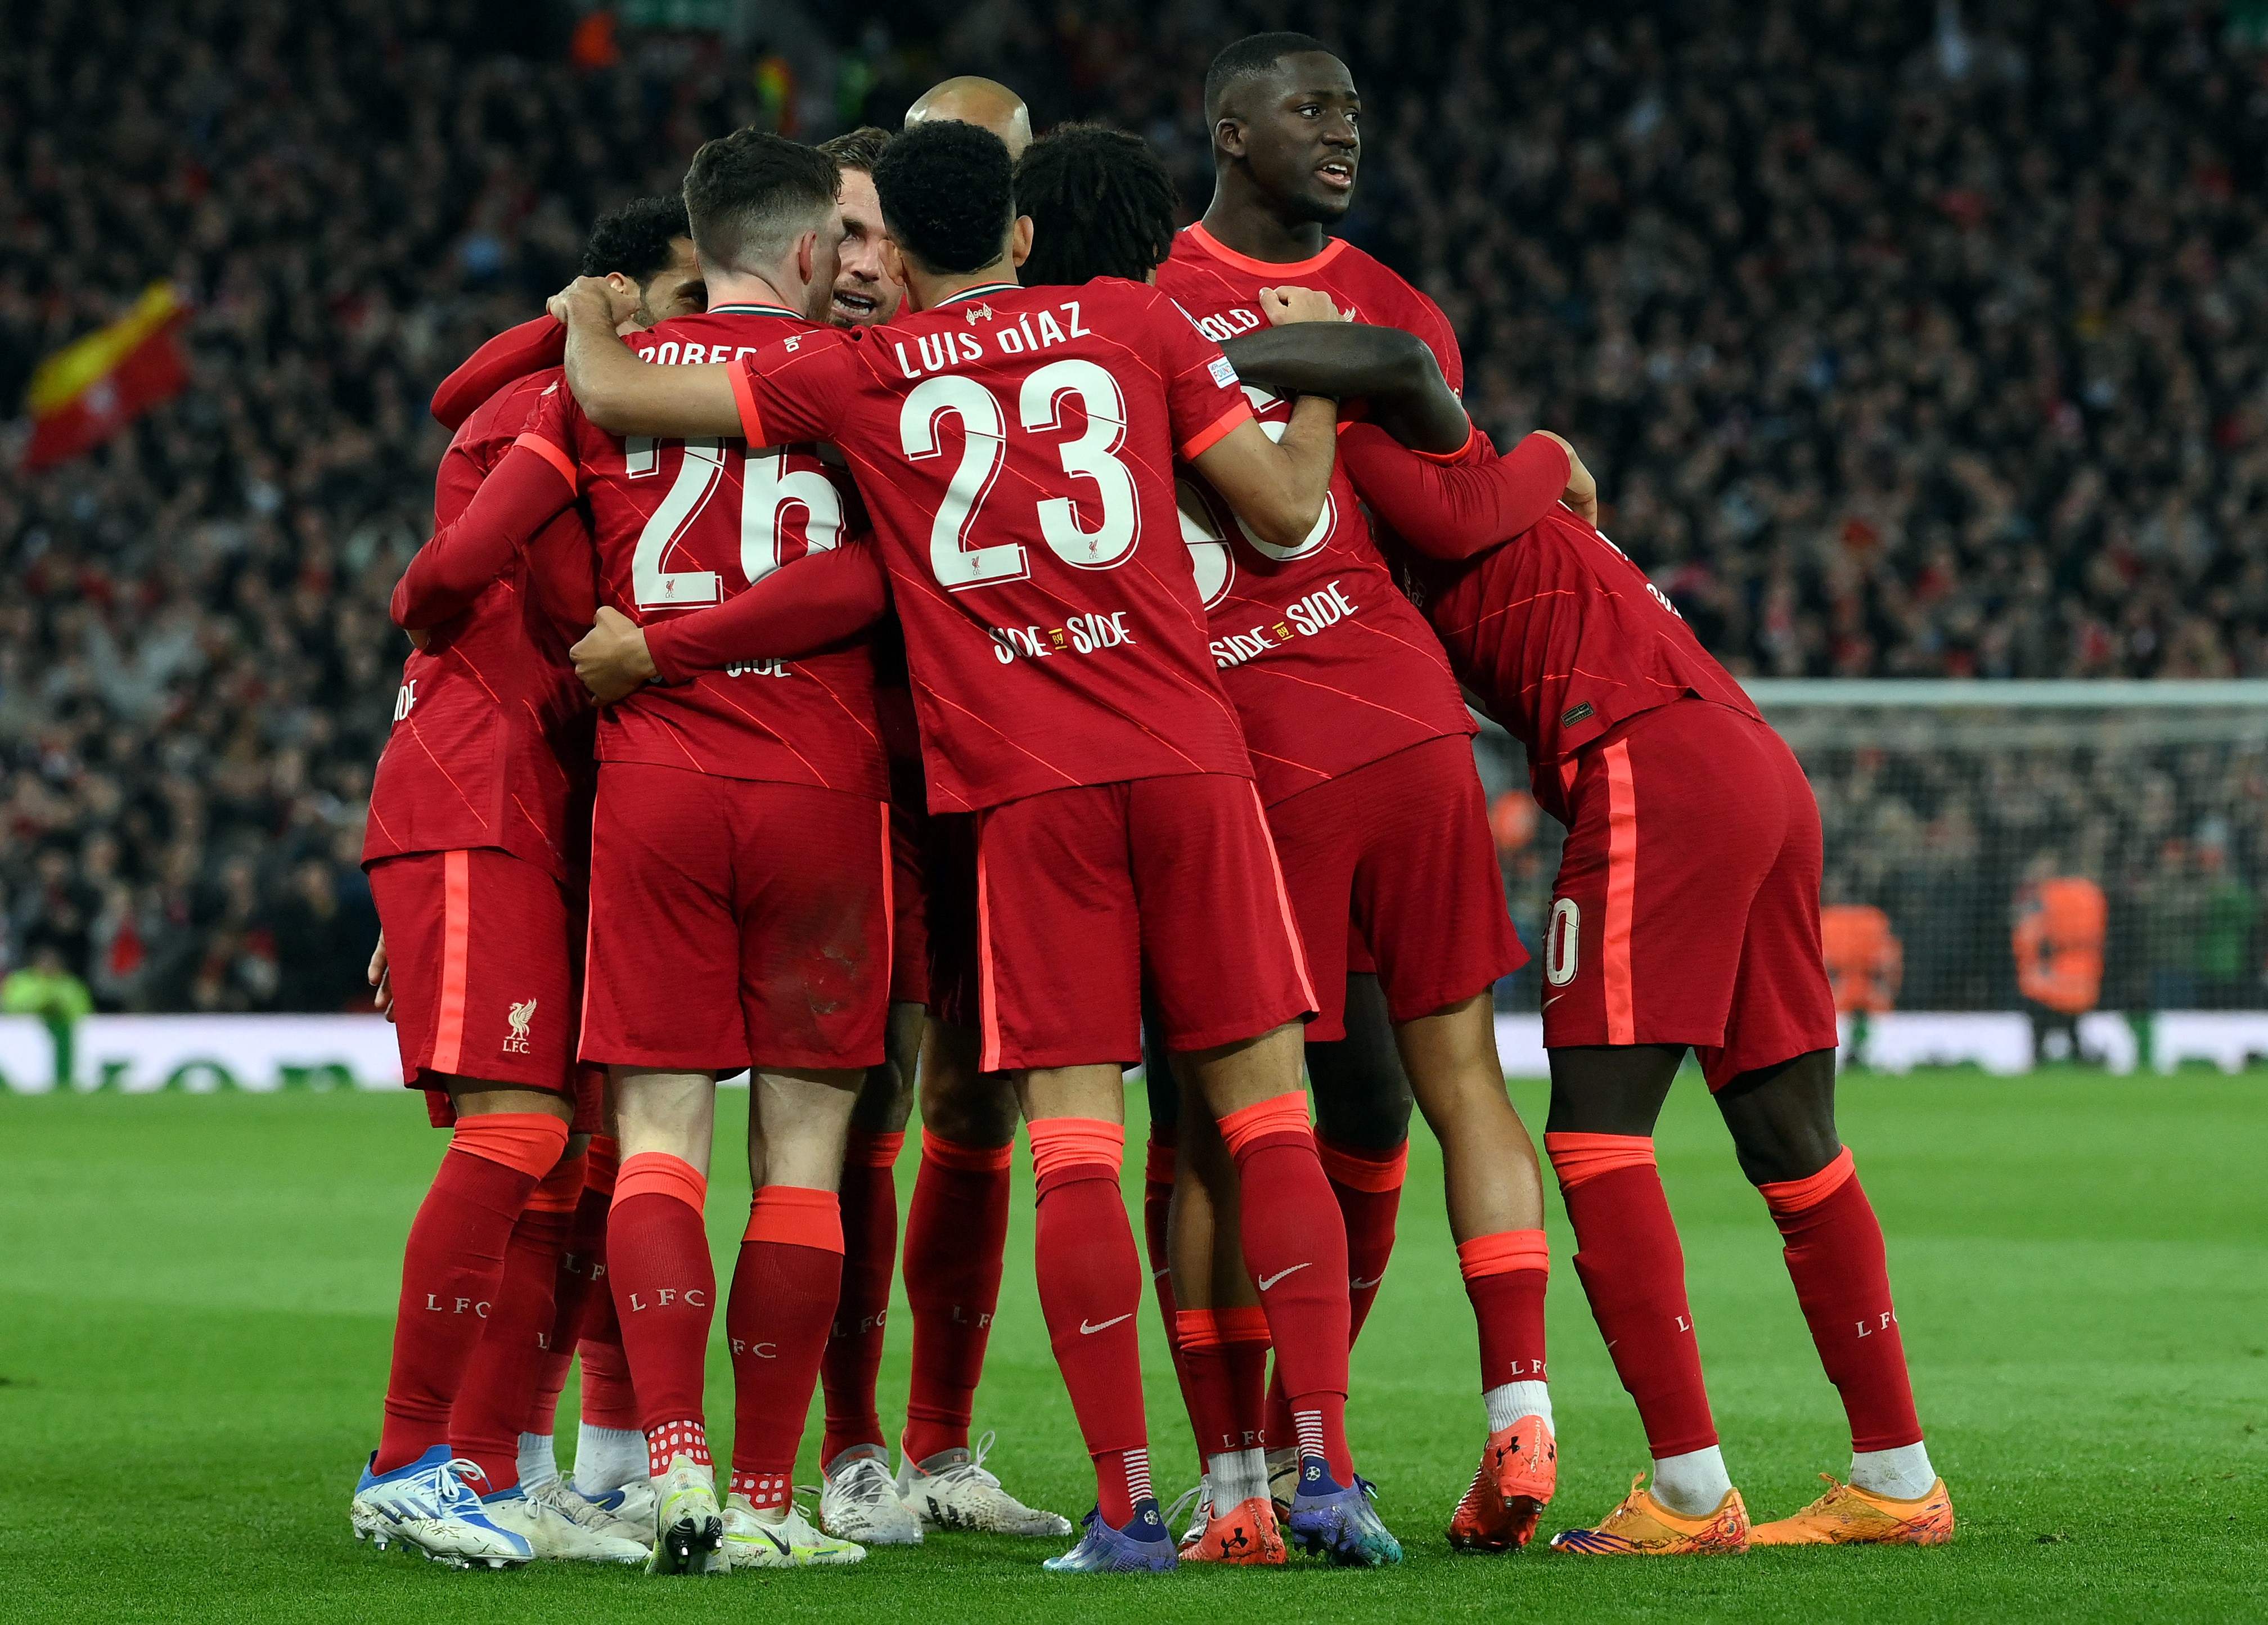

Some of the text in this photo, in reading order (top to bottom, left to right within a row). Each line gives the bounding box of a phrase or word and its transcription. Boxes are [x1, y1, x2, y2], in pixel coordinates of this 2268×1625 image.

[973, 309, 984, 318] 96
[1198, 308, 1259, 341] OLD
[895, 301, 1091, 379] LUIS DÍAZ
[900, 359, 1141, 593] 23
[625, 436, 849, 611] 26
[1286, 580, 1359, 636] SIDE
[1052, 633, 1064, 645] BY
[1066, 611, 1137, 654] SIDE
[1209, 625, 1290, 668] SIDE BY
[1545, 898, 1580, 987] 0
[564, 1252, 606, 1281] LF
[425, 1293, 492, 1319] LFC
[629, 1289, 705, 1312] LFC
